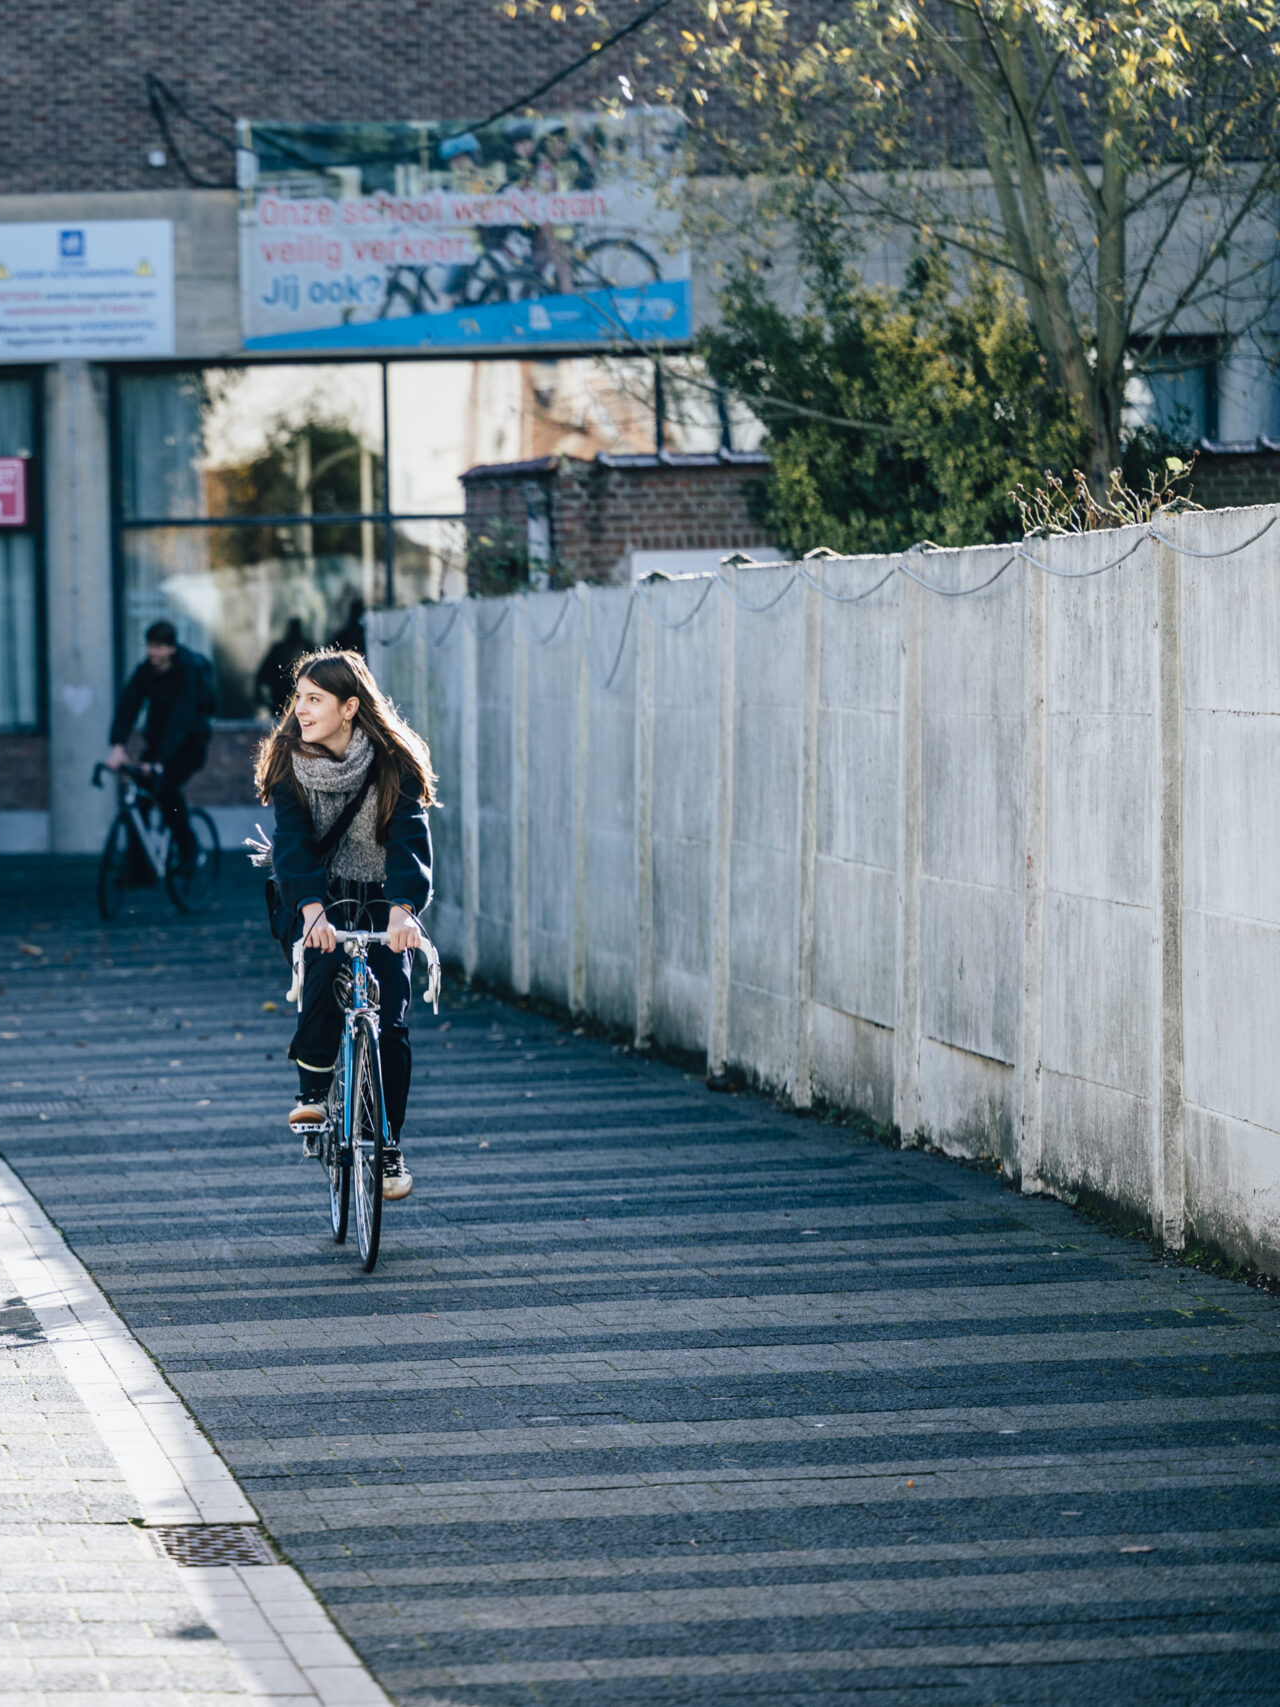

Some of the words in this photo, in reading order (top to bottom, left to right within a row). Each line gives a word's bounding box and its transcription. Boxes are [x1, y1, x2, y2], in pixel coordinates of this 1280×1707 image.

[261, 199, 332, 227] Onze
[342, 194, 442, 225] school
[551, 195, 607, 219] aan
[260, 232, 342, 271] veilig
[261, 273, 300, 312] Jij
[309, 273, 381, 304] ook?
